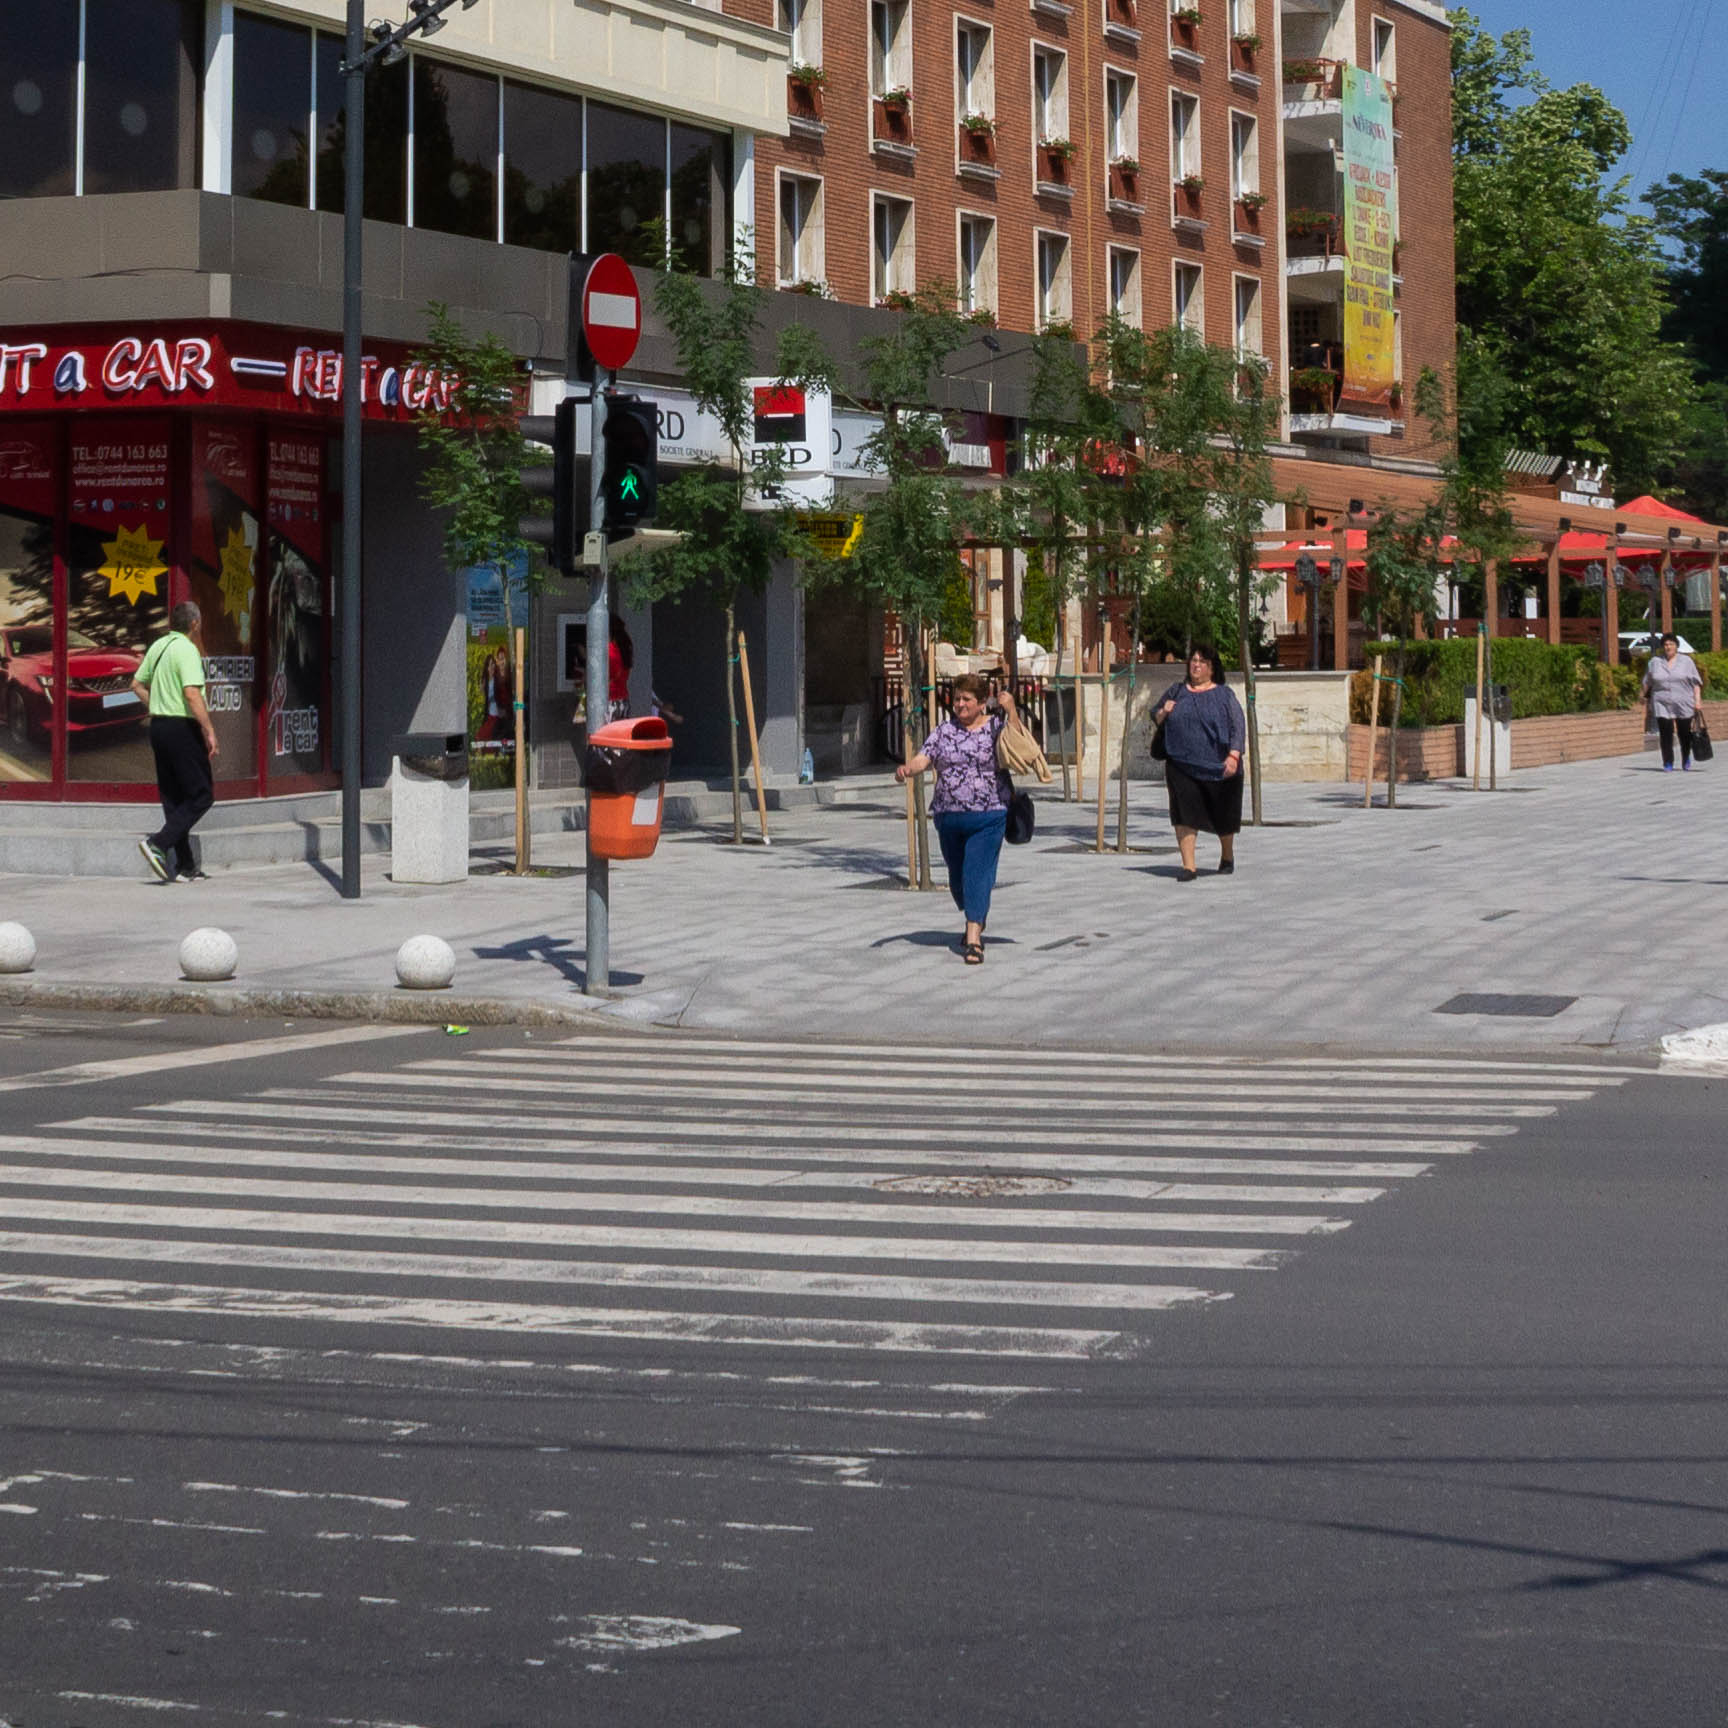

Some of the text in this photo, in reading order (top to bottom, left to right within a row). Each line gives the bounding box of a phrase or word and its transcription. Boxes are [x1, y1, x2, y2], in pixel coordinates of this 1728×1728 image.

[54, 351, 87, 391] a
[102, 337, 214, 393] CAR
[292, 346, 380, 403] RET
[206, 684, 242, 712] AUTO
